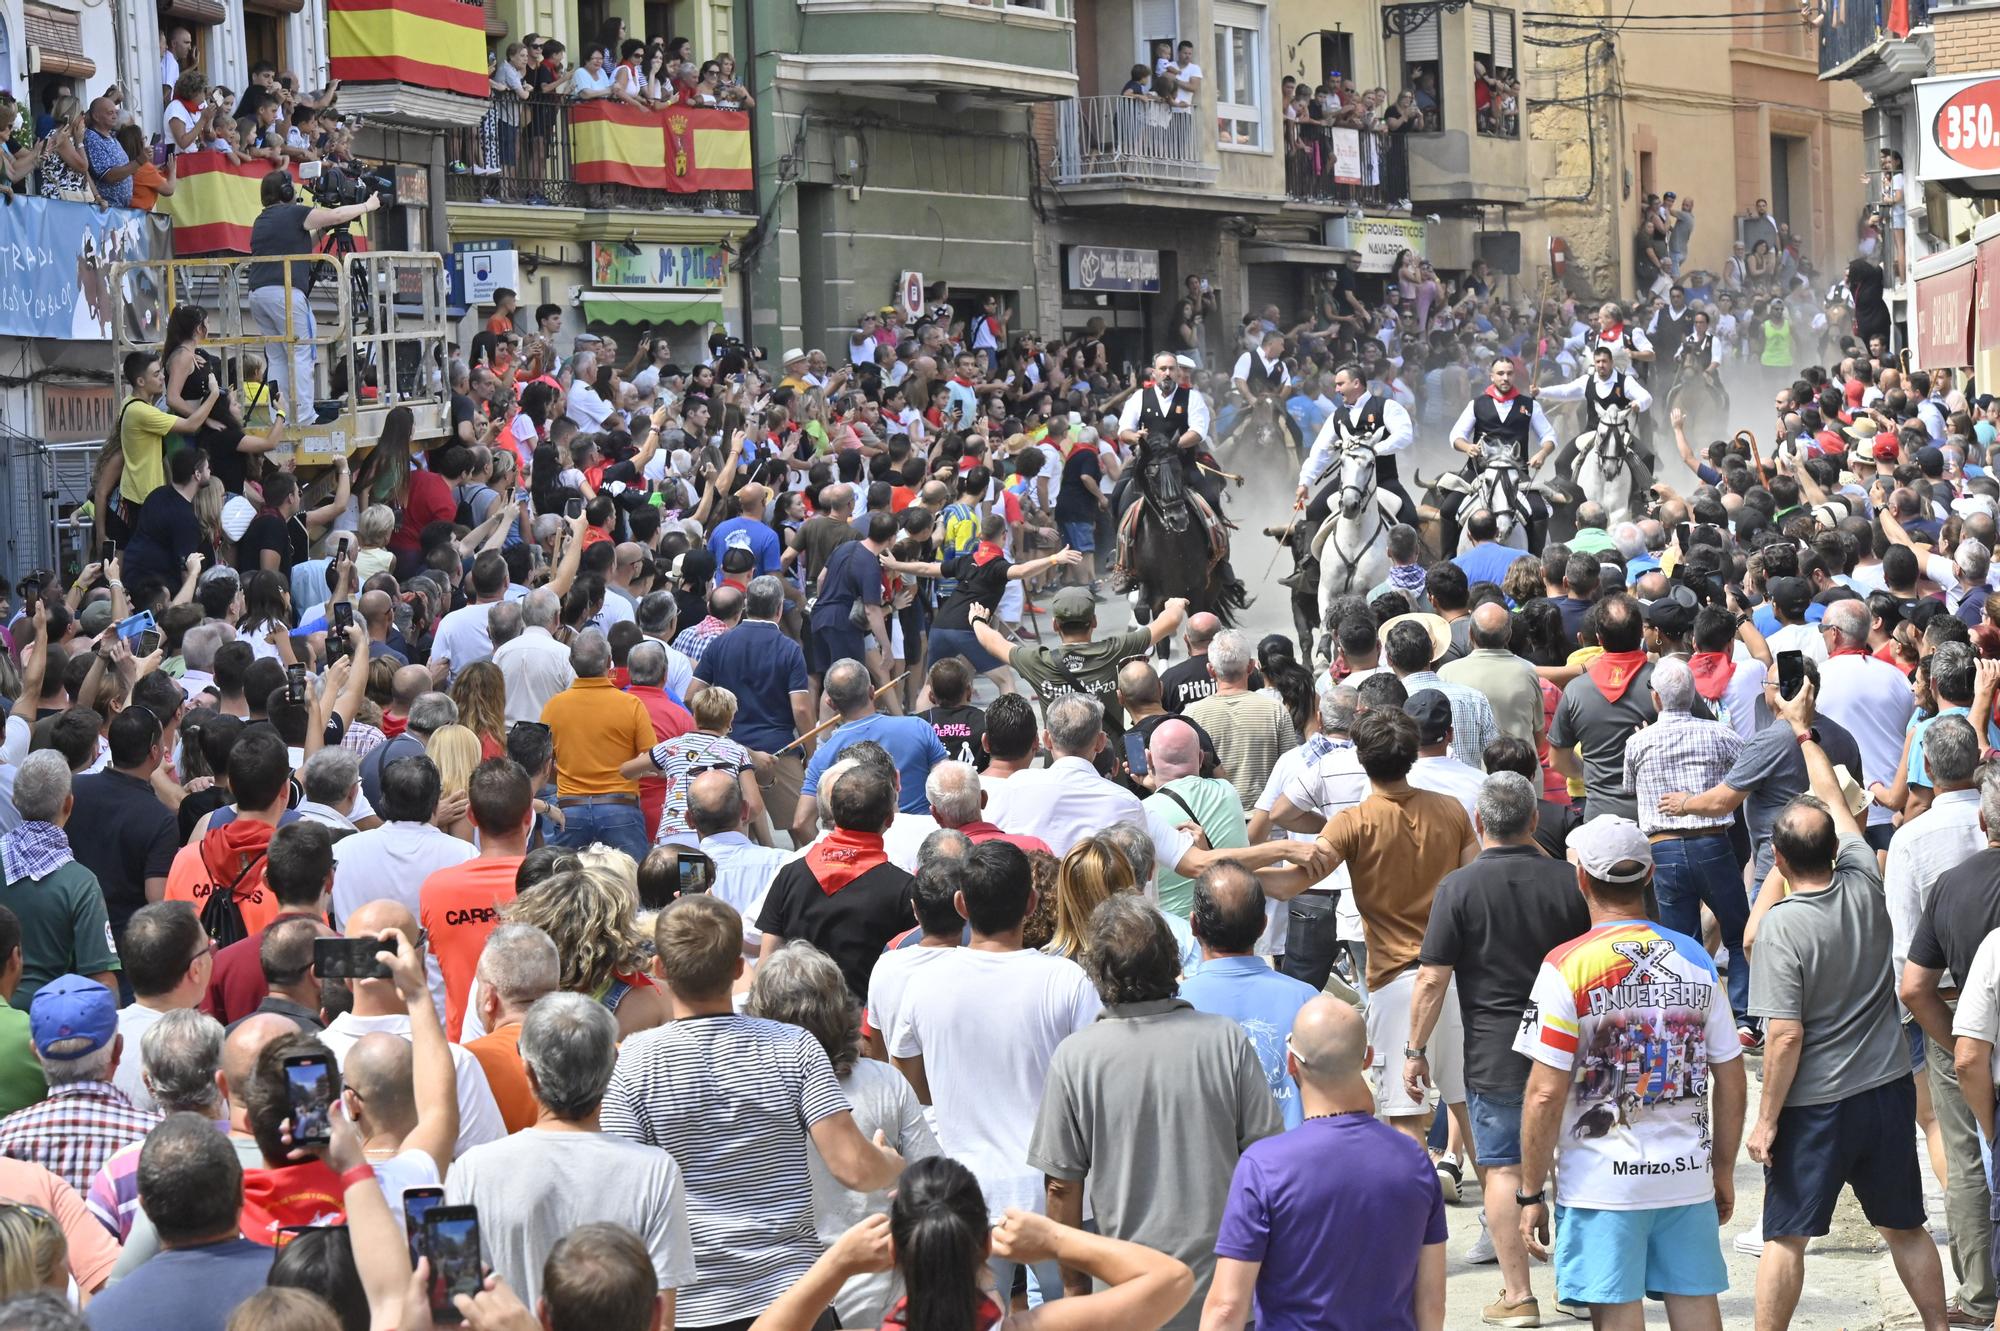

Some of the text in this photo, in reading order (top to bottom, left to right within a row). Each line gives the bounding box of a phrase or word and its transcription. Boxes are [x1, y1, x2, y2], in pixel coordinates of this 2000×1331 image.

[1368, 242, 1403, 255] NAVARRO
[681, 246, 723, 287] Pilar
[1612, 940, 1681, 984] X
[1613, 1156, 1702, 1176] Marizo,S.L.
